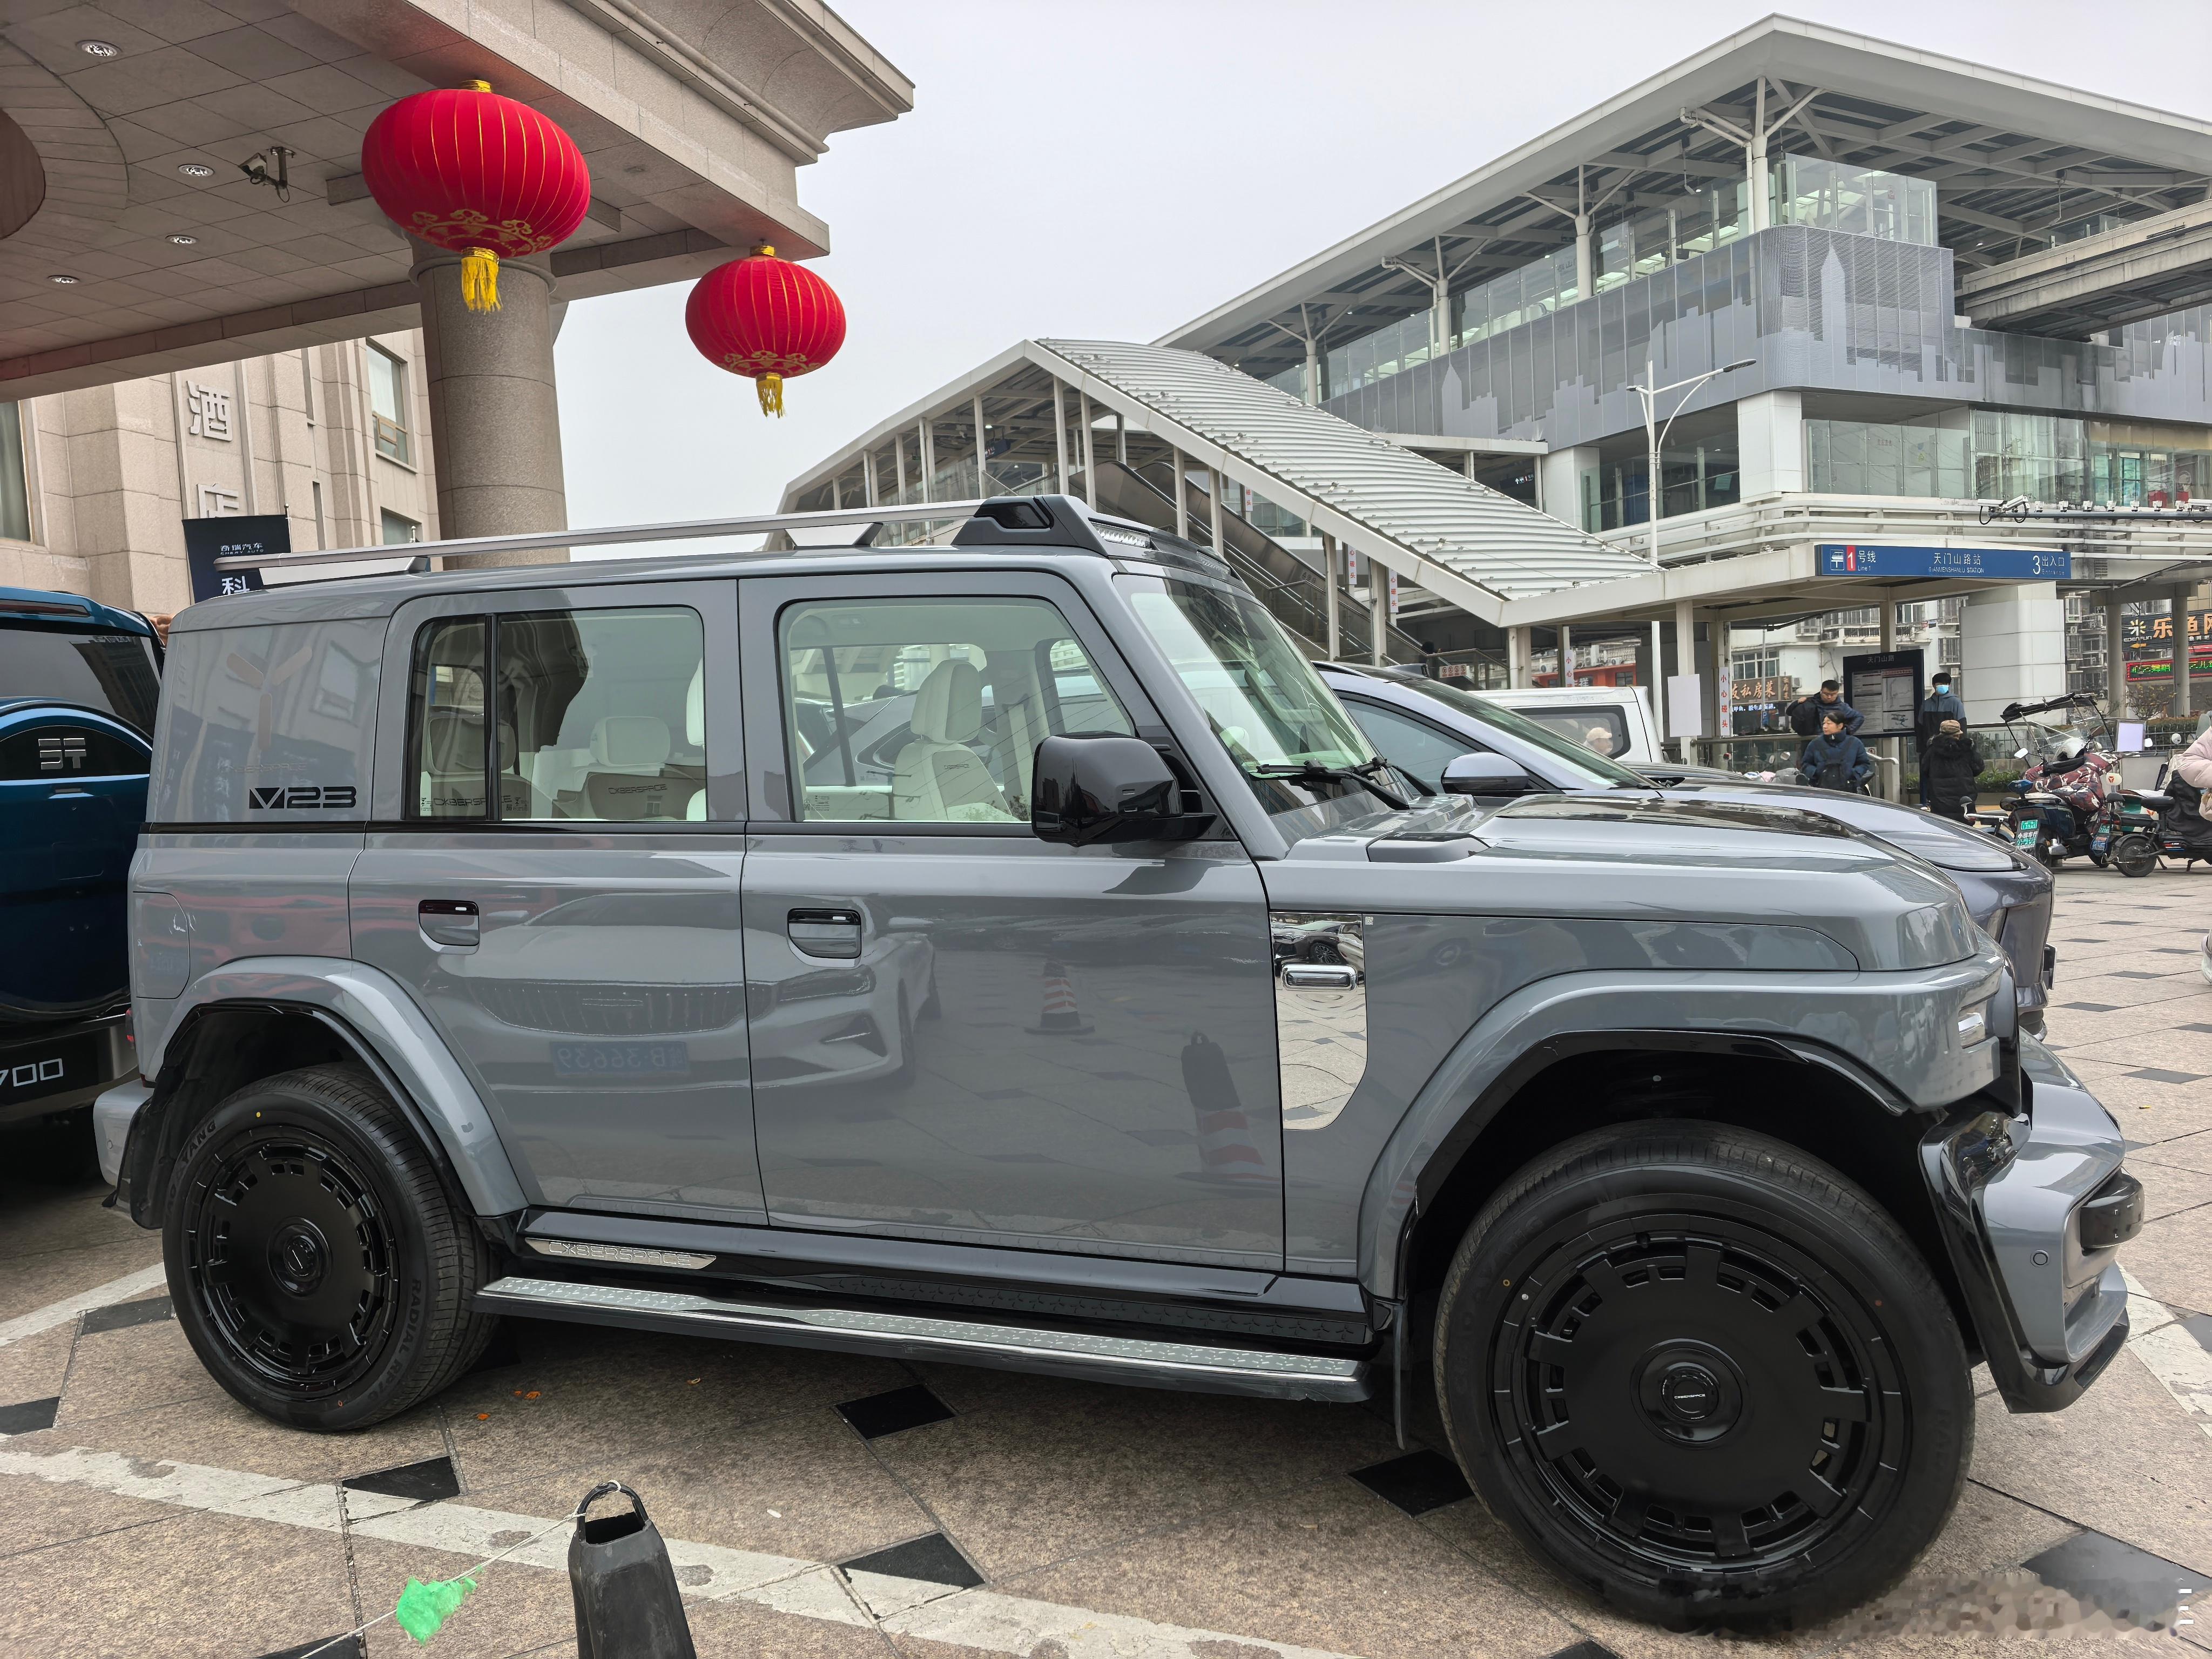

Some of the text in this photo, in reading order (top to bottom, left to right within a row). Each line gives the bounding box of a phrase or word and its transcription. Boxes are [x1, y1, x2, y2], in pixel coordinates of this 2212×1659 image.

[1934, 552, 1981, 565] 天门山路站
[221, 576, 249, 595] 科
[1867, 655, 1895, 664] 天门山路
